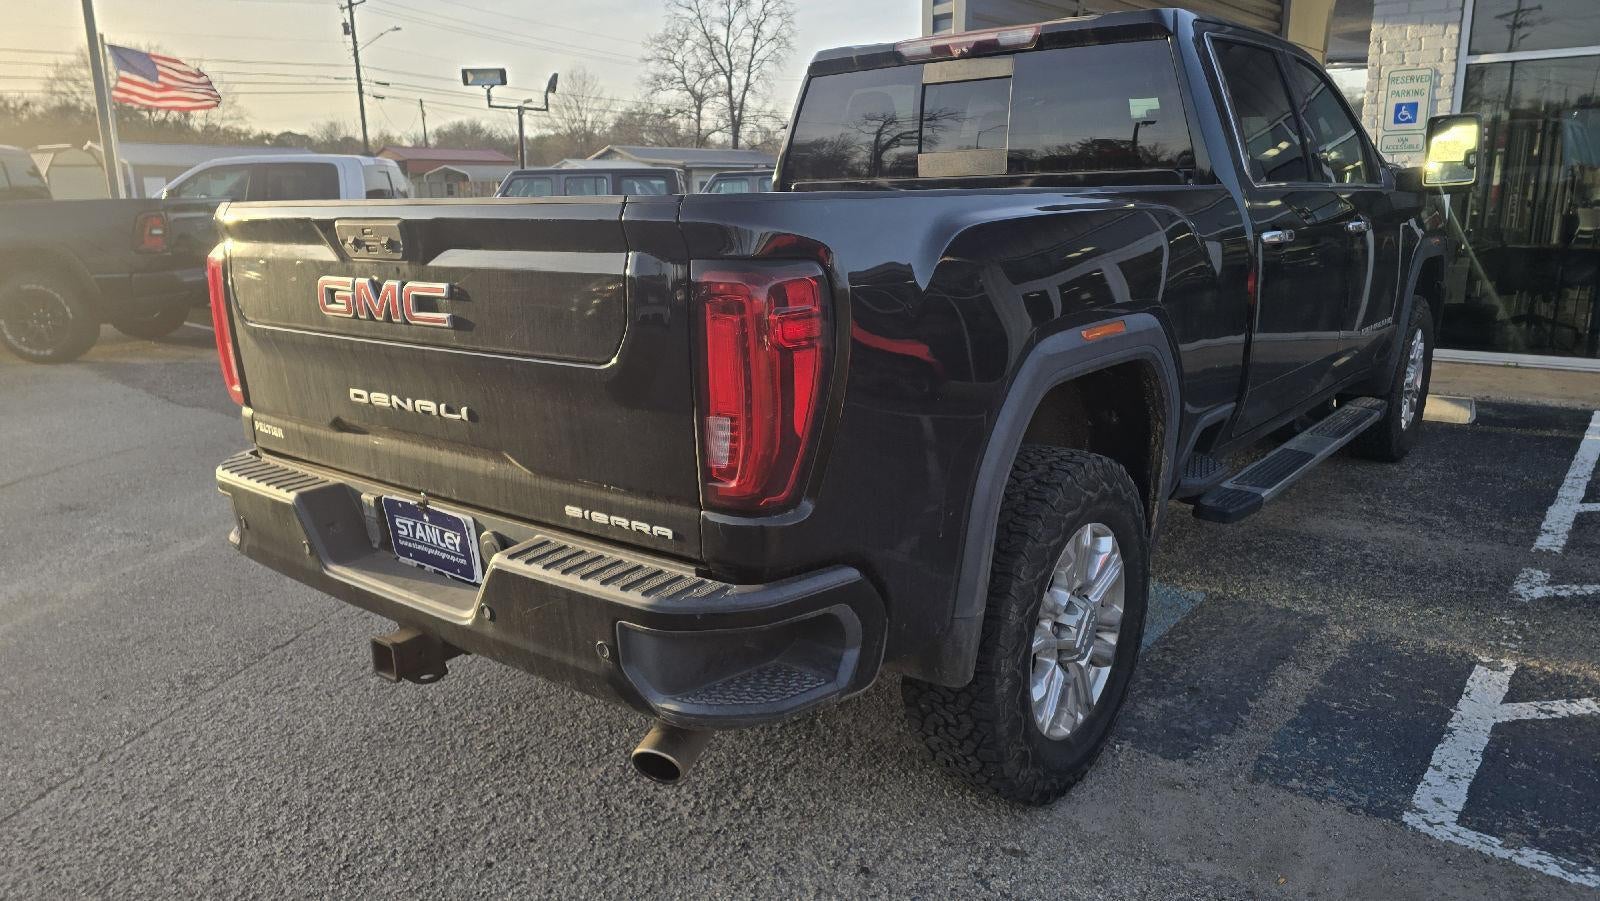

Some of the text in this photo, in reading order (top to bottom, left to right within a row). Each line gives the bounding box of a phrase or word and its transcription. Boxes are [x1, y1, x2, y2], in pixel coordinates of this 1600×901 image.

[1391, 75, 1430, 85] RESERVED
[1391, 89, 1425, 98] PARKING
[318, 275, 452, 327] GMC
[349, 387, 468, 421] DENALI
[395, 517, 460, 552] STANLEY
[564, 505, 673, 540] SIERRA
